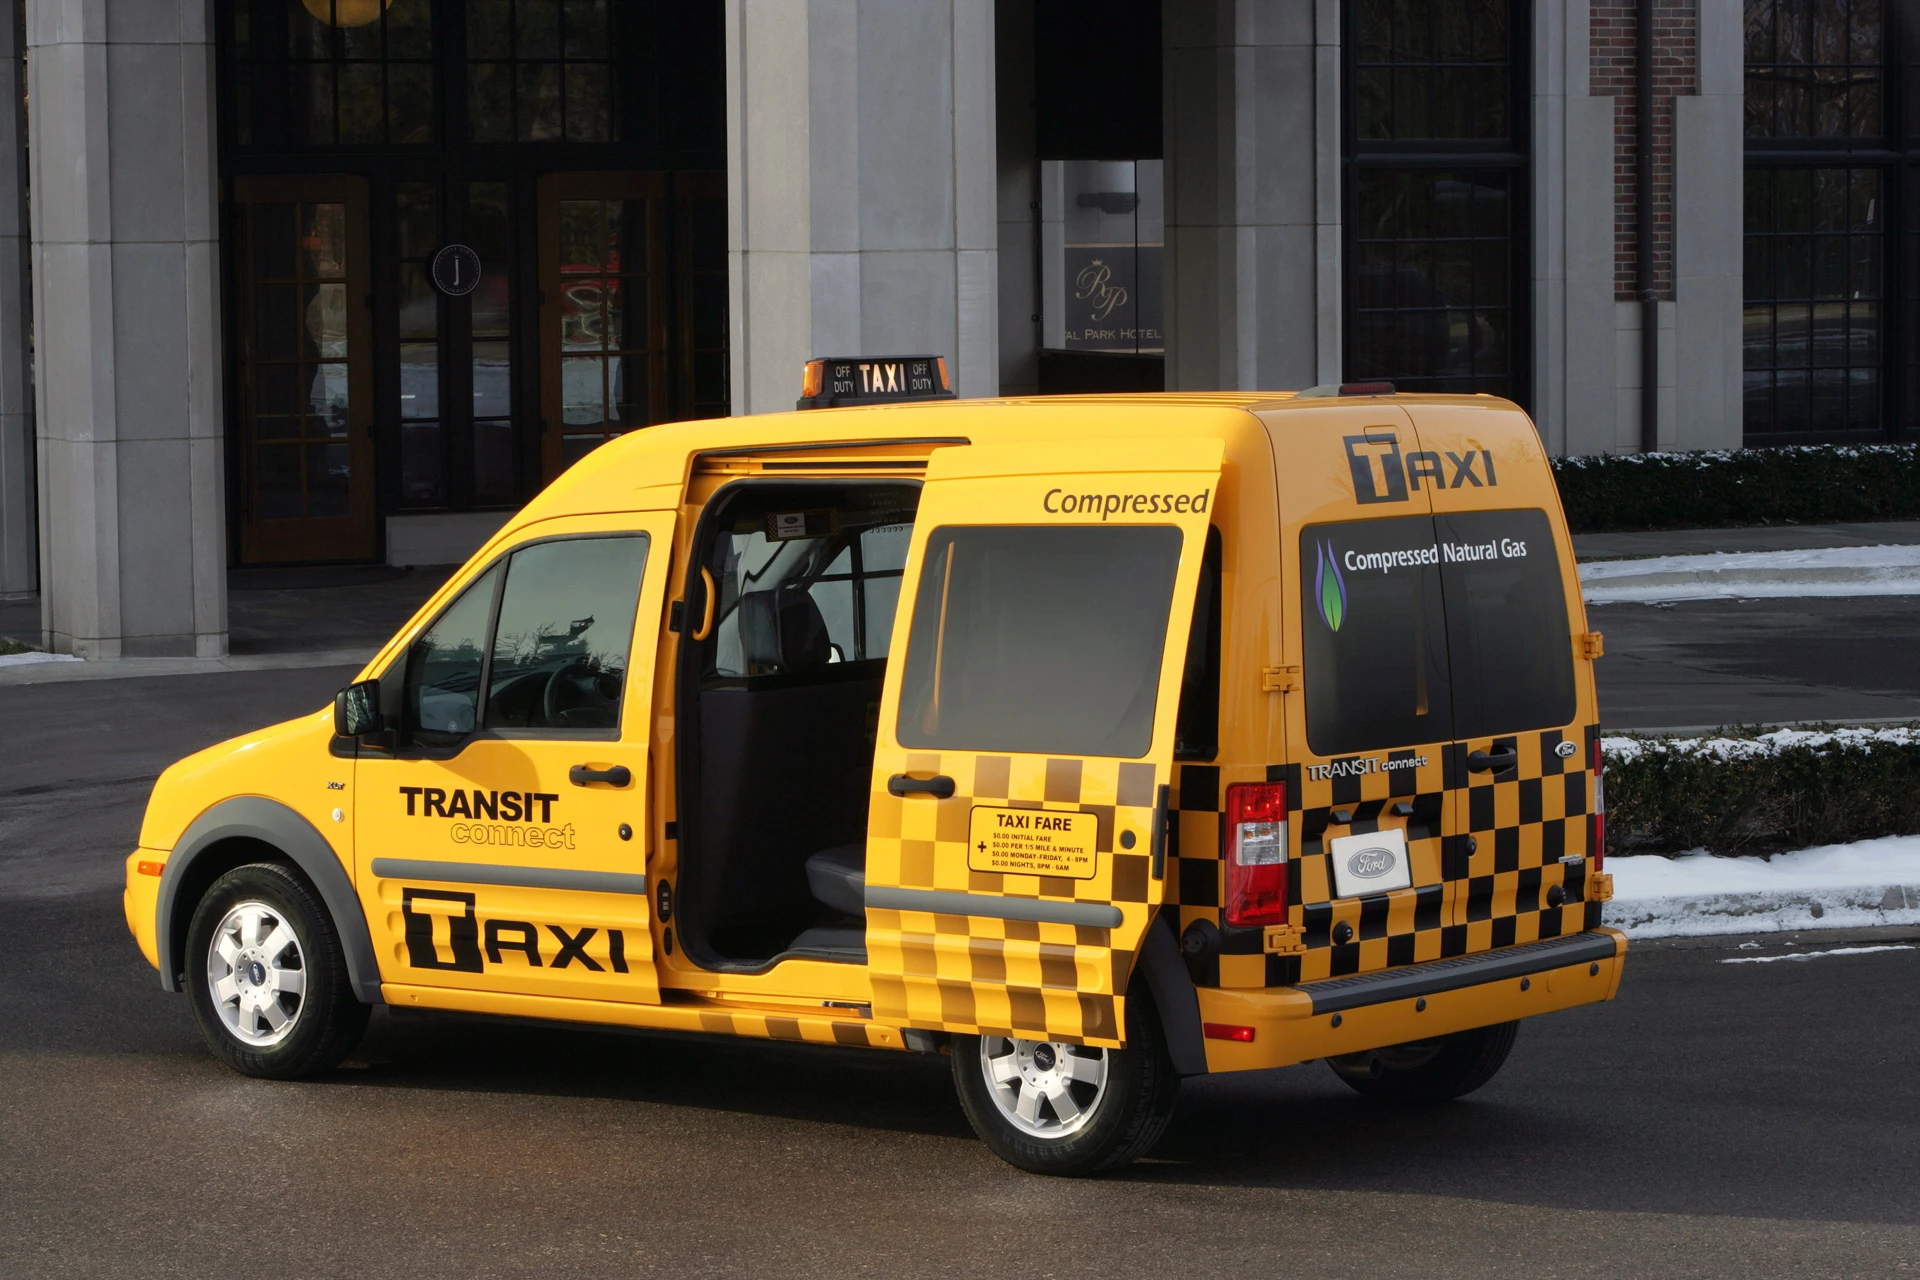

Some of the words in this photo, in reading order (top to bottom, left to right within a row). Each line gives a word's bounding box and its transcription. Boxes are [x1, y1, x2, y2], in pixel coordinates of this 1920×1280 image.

[1085, 329, 1116, 340] PARK
[1121, 328, 1161, 339] HOTEL
[835, 366, 851, 378] OFF
[912, 363, 927, 375] OFF
[859, 363, 906, 393] TAXI
[912, 378, 932, 390] DUTY
[834, 381, 854, 393] DUTY
[1343, 433, 1497, 505] TAXI
[1043, 488, 1210, 521] Compressed
[1344, 544, 1439, 574] Compressed
[1443, 540, 1497, 563] Natural
[1501, 538, 1527, 558] Gas
[1307, 757, 1379, 781] TRANSIT
[1381, 755, 1428, 771] connect
[399, 786, 559, 823] TRANSIT
[997, 814, 1030, 828] TAXI
[1035, 816, 1072, 831] FARE
[451, 823, 576, 850] connect
[993, 832, 1010, 840] $0.00
[1011, 834, 1034, 842] INITIAL
[1035, 835, 1052, 843] FARE
[992, 841, 1009, 849] $0.00
[1059, 846, 1084, 854] MINUTE
[992, 850, 1009, 858] $0.00
[991, 859, 1008, 867] $0.00
[1010, 861, 1036, 870] NIGHTS,
[1358, 852, 1386, 873] Ford
[402, 887, 629, 974] TAXI
